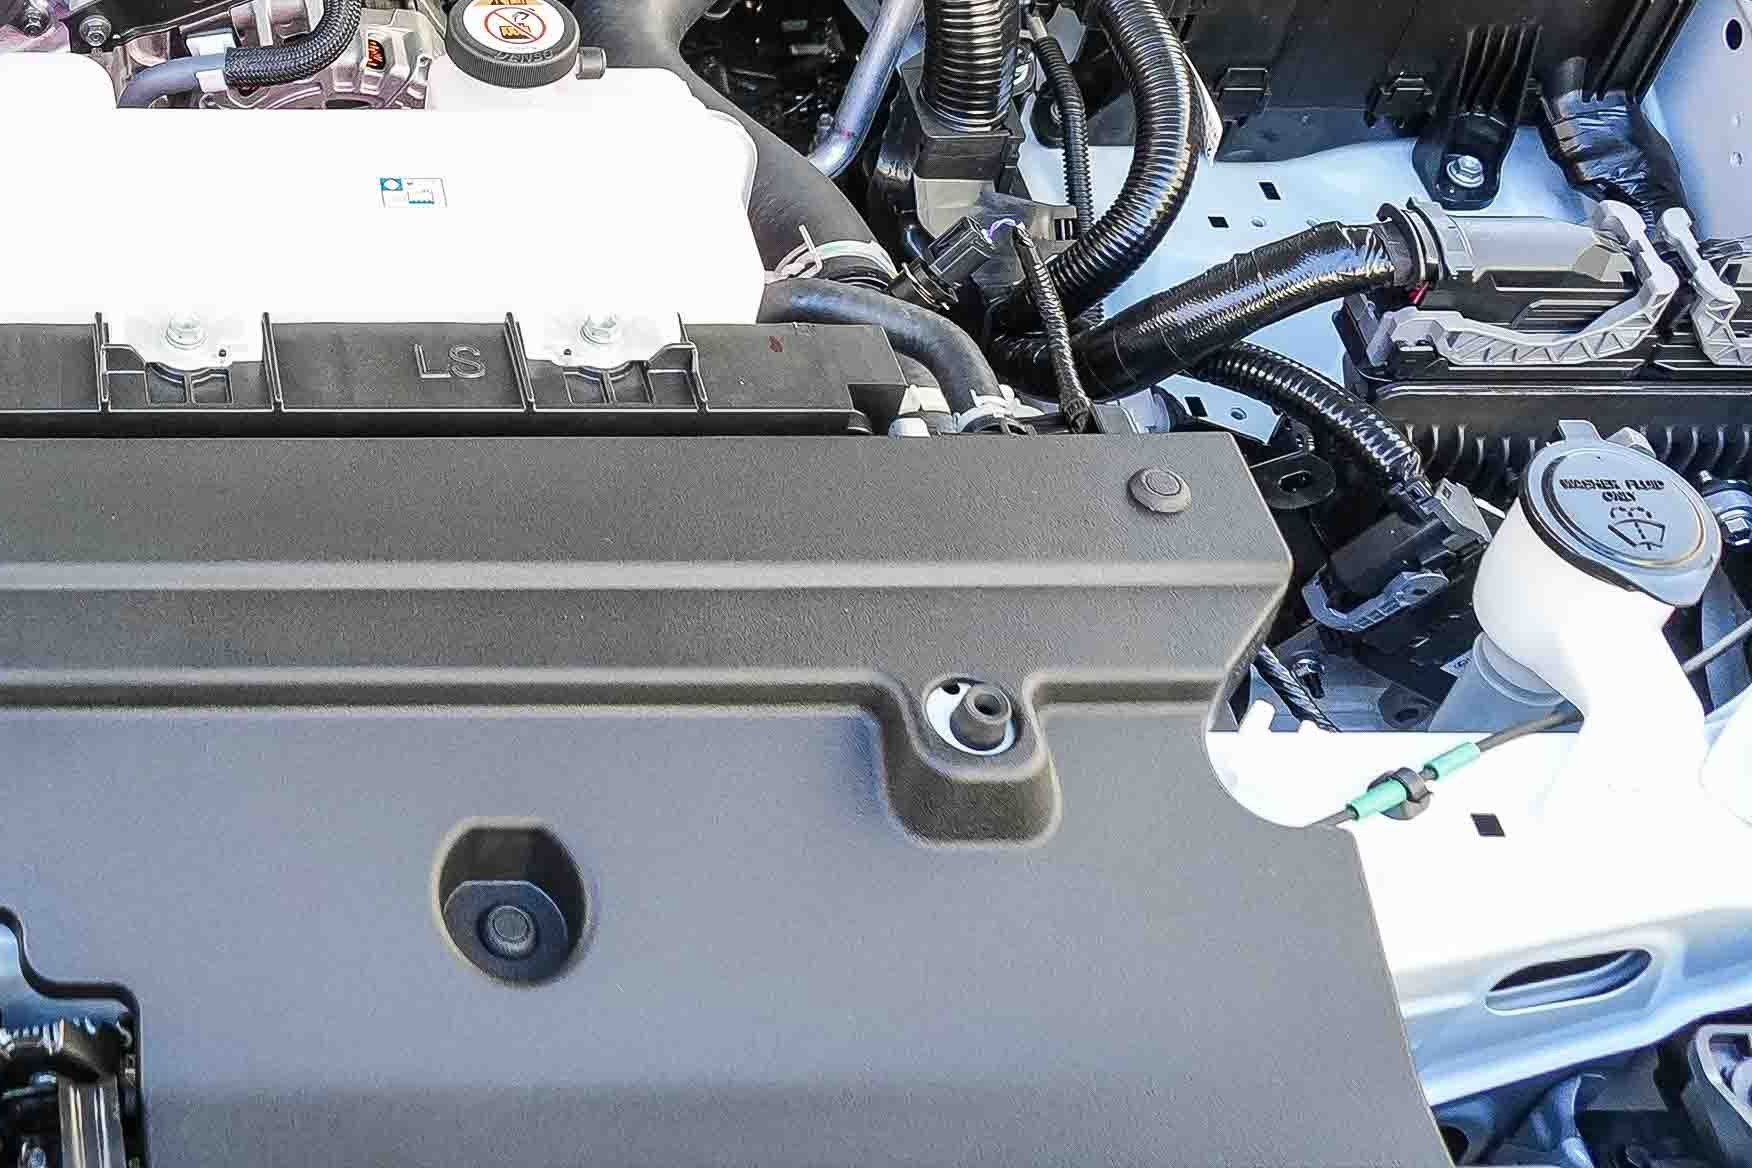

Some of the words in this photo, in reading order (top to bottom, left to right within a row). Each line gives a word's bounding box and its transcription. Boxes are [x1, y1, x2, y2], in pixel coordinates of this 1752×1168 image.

[413, 343, 486, 379] LS
[1560, 478, 1621, 490] WASHER
[1624, 478, 1666, 491] FLUID
[1602, 491, 1637, 502] ONLY
